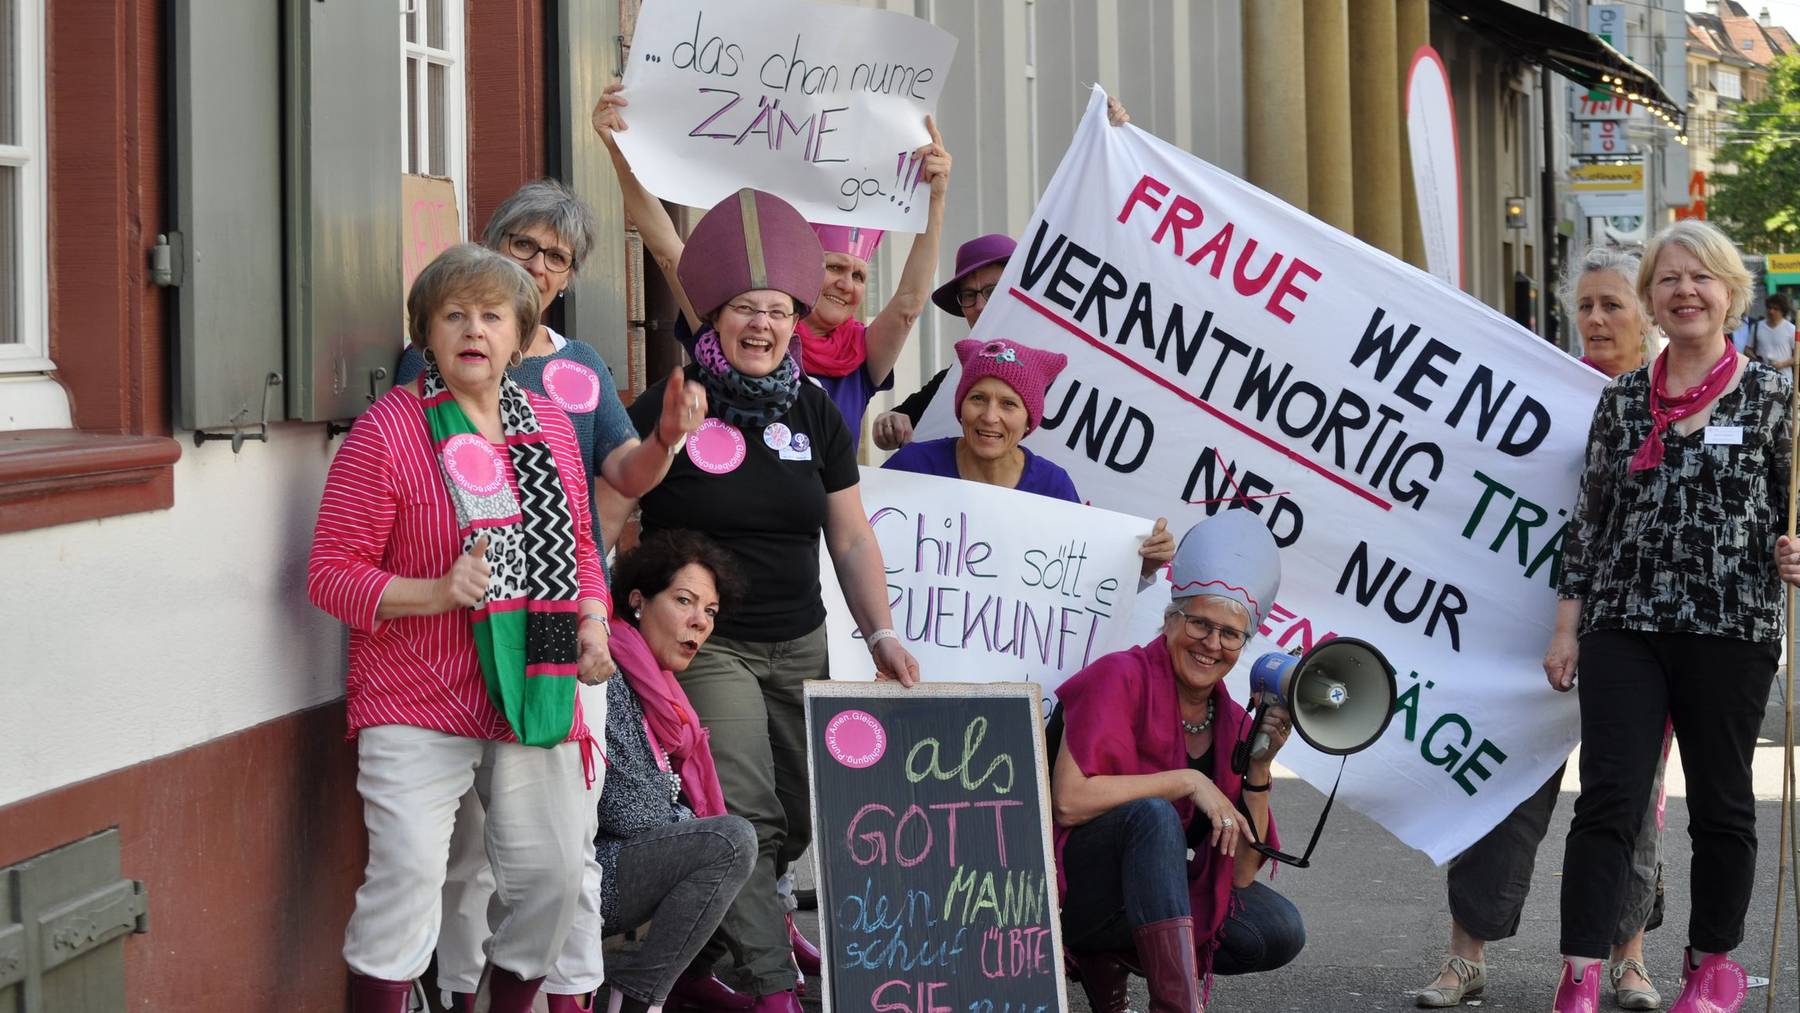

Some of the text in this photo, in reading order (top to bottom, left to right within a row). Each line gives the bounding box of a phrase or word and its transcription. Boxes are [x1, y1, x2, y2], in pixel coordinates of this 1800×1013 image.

[760, 34, 838, 96] chan
[850, 61, 934, 100] nume
[688, 87, 849, 162] ZÄME
[1117, 174, 1322, 323] FRAUE
[1350, 307, 1551, 457] WEND
[1019, 219, 1444, 511] VERANTWORTIG
[1462, 470, 1569, 589] TRÄ
[868, 507, 998, 577] Chile
[1039, 380, 1154, 473] UND
[1336, 541, 1468, 652] NUR
[905, 716, 1014, 794] als
[1394, 670, 1508, 796] ÄGE
[847, 802, 1024, 868] GOTT
[944, 864, 1046, 928] MANN
[841, 924, 1051, 979] schuf ÜBTE
